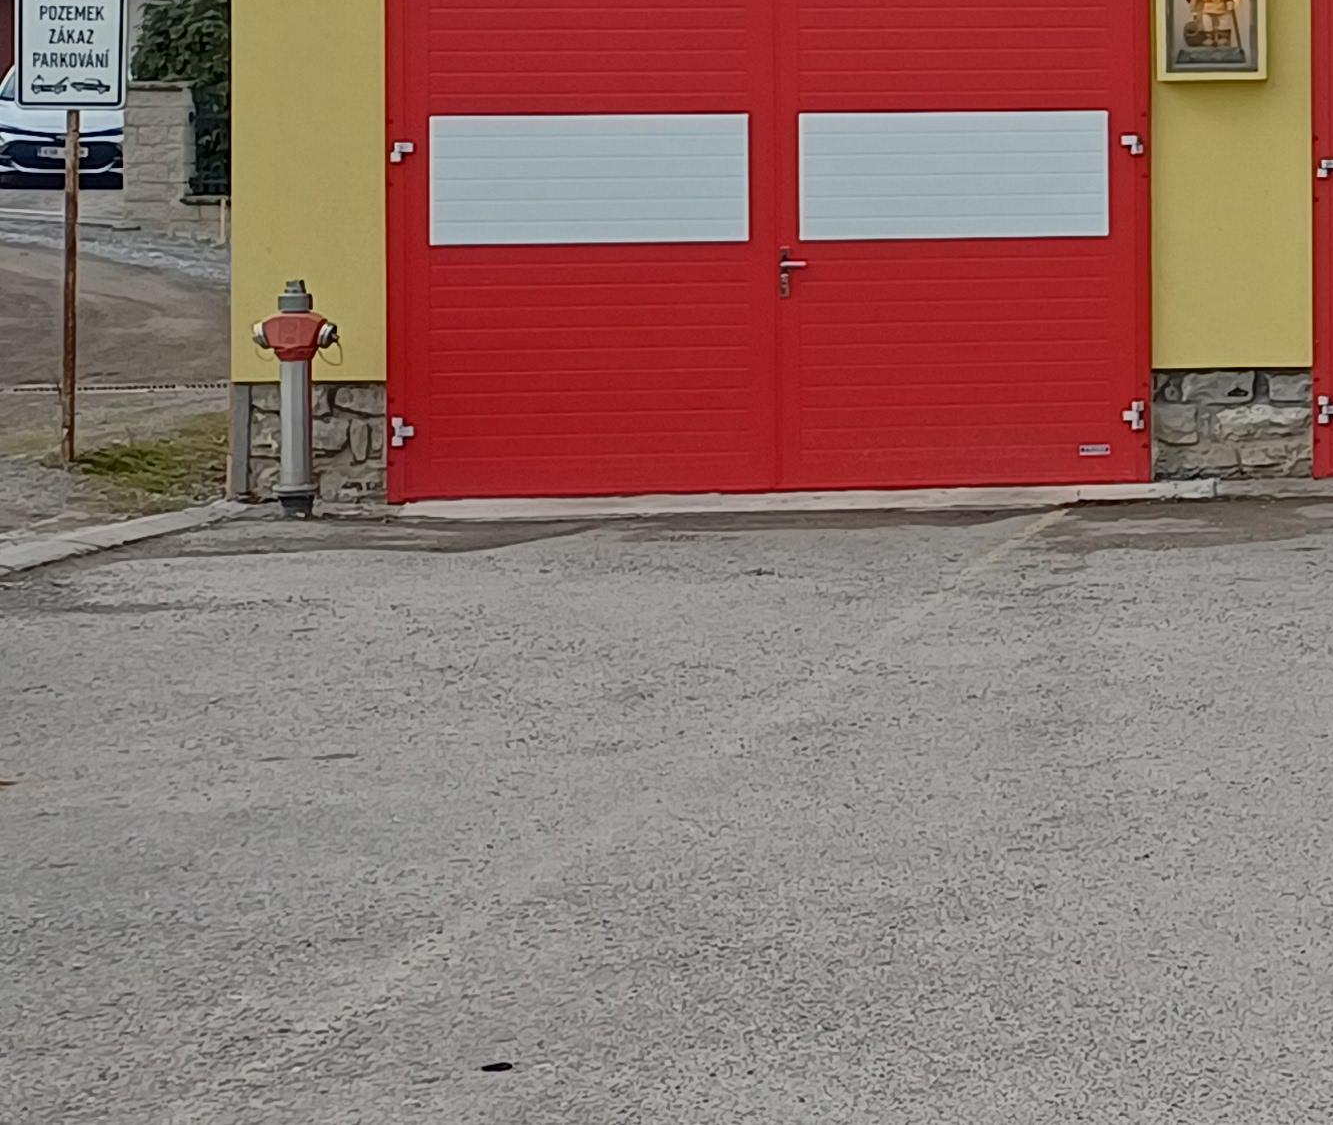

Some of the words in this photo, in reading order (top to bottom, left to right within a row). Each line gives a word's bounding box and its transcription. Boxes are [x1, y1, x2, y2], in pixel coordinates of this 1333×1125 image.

[39, 5, 105, 21] POZEMEK
[48, 25, 95, 45] ZÁKAZ
[32, 49, 110, 68] PARKOVÁNÍ
